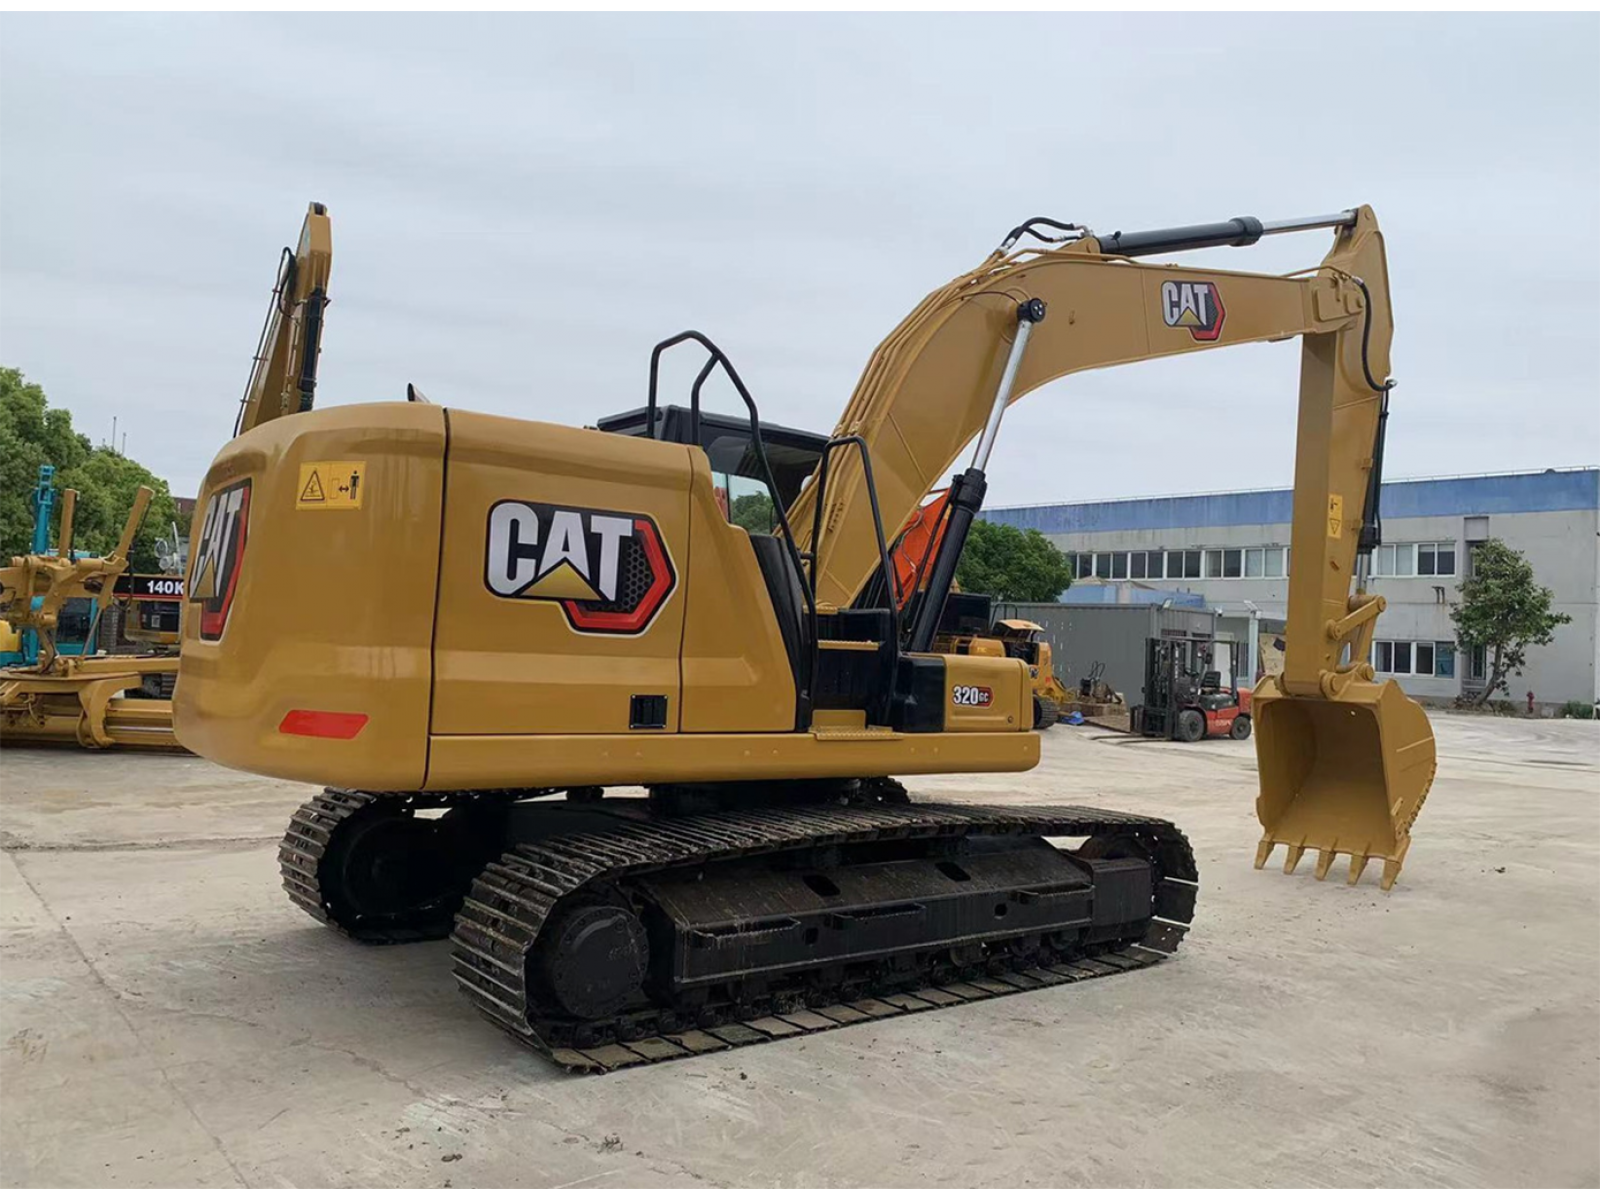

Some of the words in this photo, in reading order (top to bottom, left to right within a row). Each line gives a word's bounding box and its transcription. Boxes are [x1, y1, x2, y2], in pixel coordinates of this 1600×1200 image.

[1162, 282, 1208, 326] CAT
[190, 488, 244, 598] CAT
[488, 502, 633, 602] CAT
[147, 580, 184, 595] 140K
